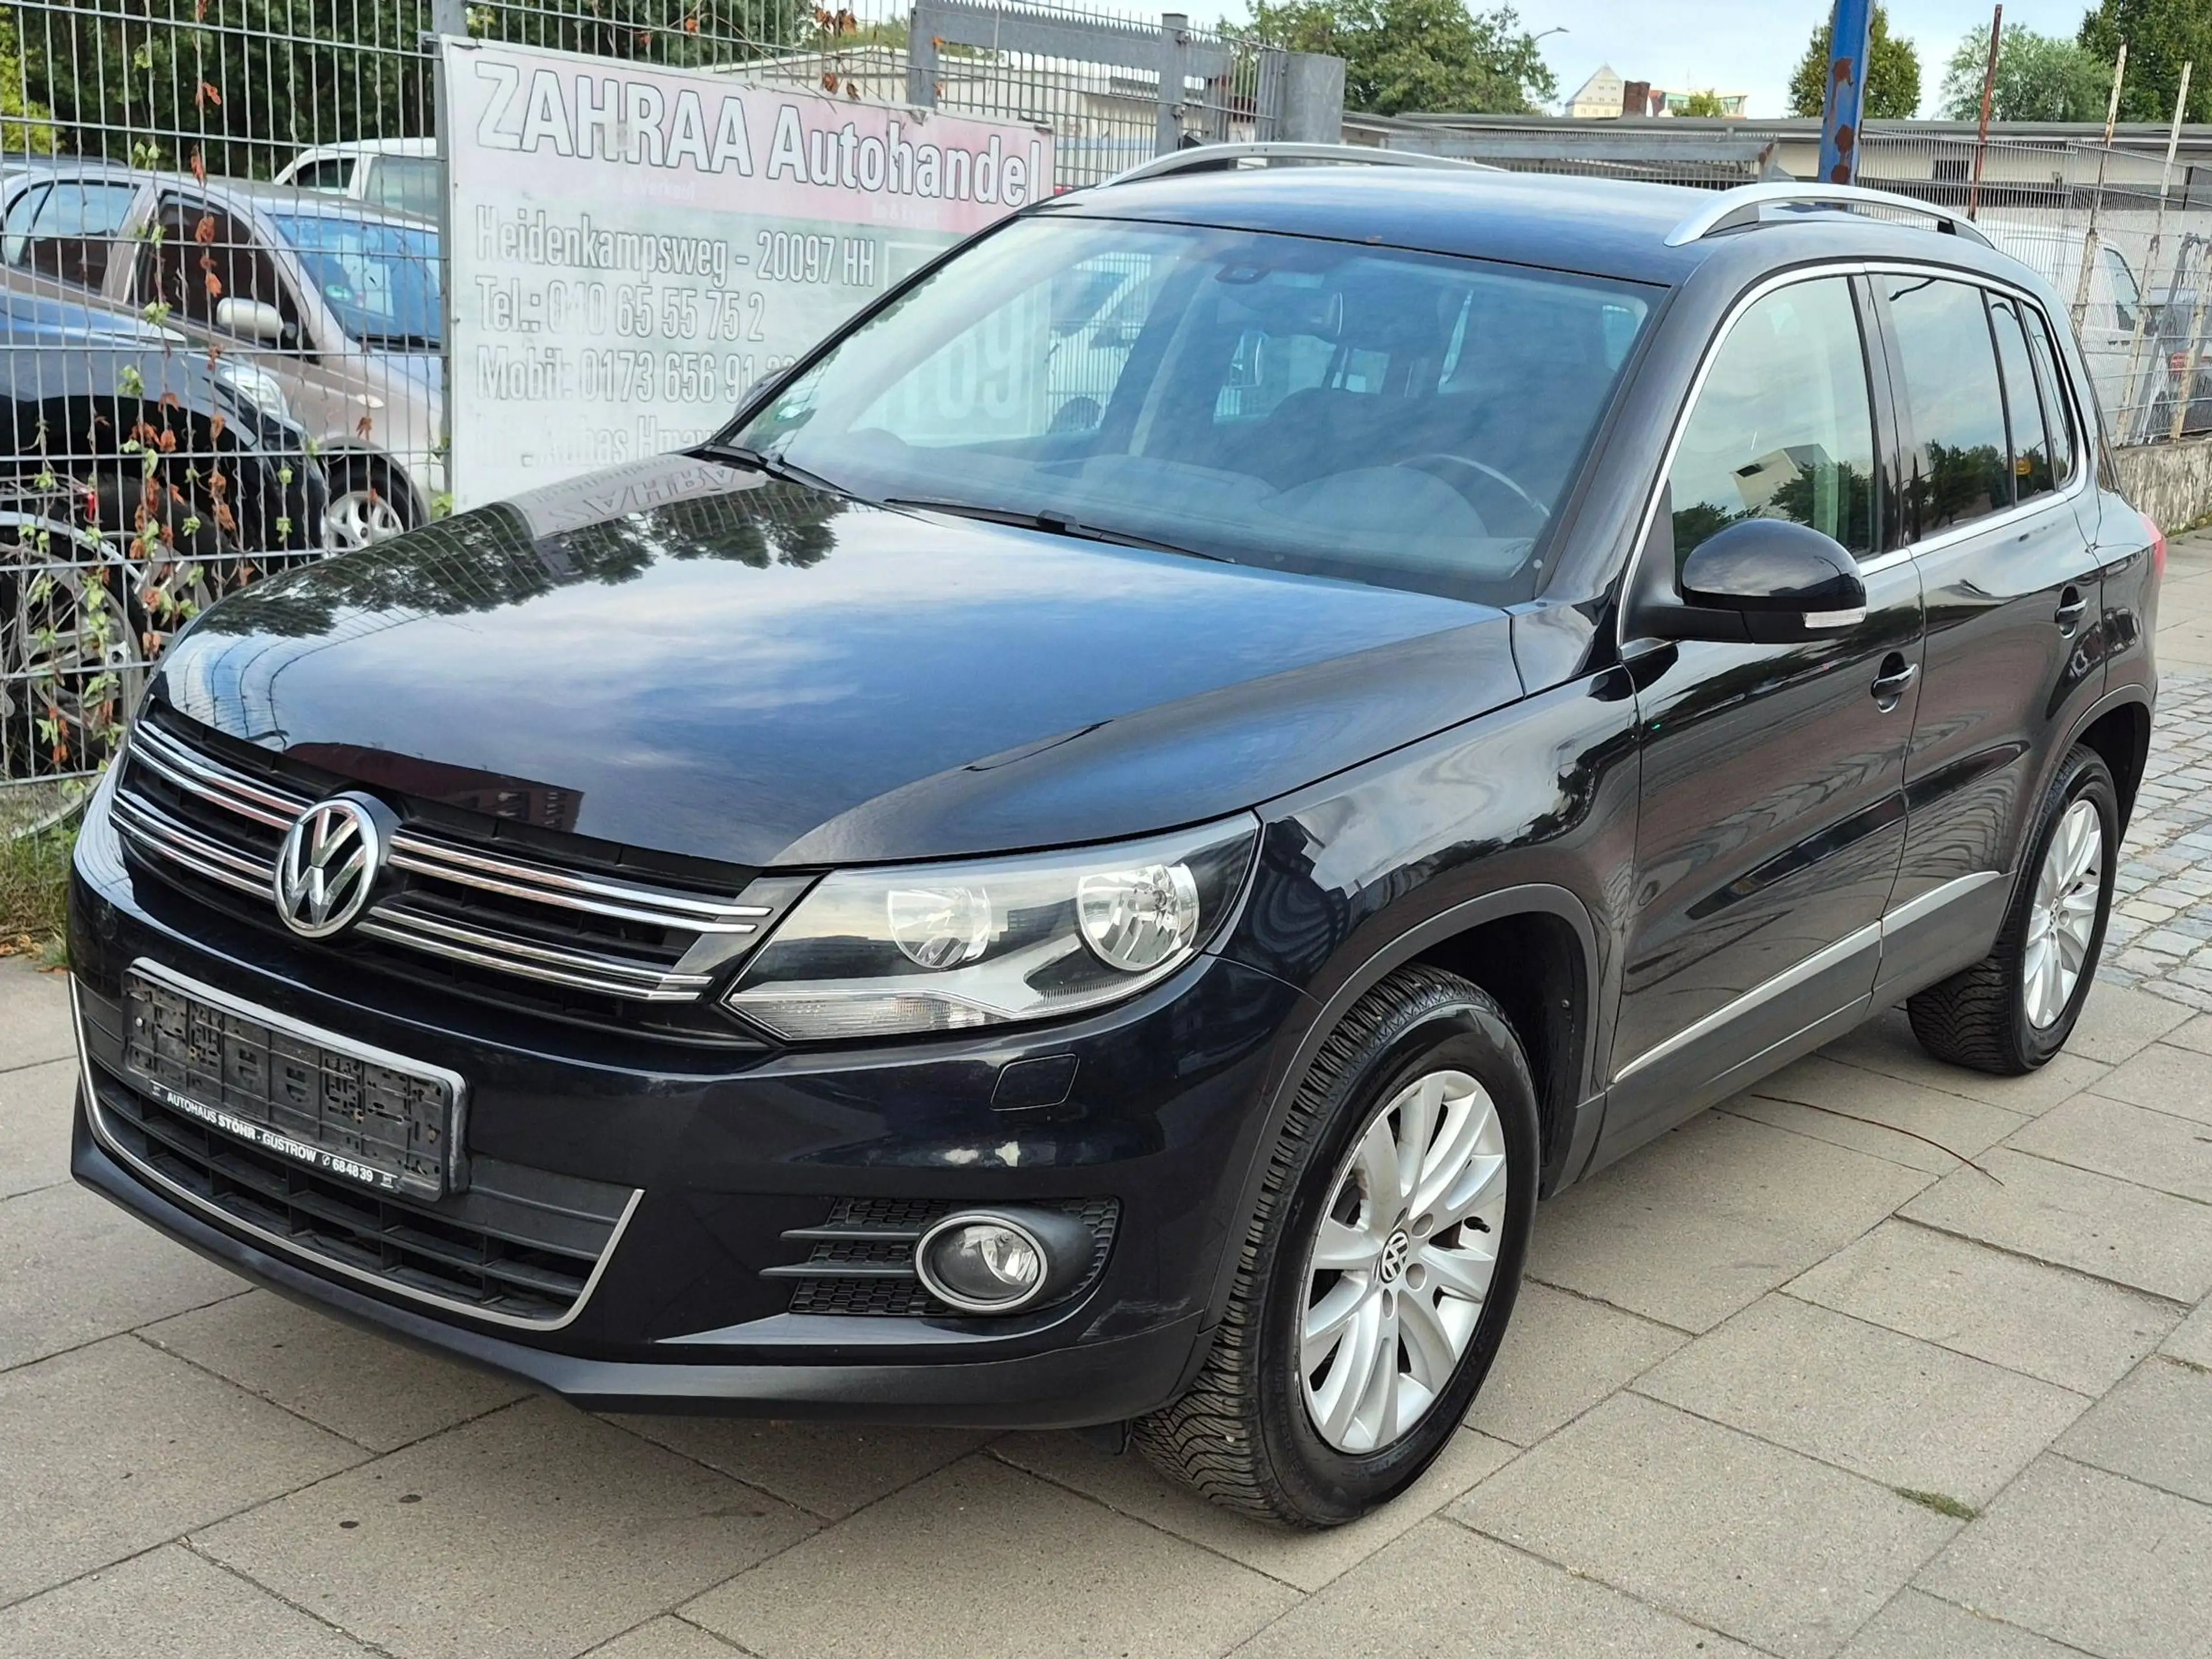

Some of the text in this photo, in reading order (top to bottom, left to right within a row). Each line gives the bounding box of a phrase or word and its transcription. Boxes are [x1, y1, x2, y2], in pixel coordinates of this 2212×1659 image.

[475, 61, 1041, 206] ZAHRAA Autohandel
[476, 205, 875, 287] Heidenkampsweg - 20097 HH
[475, 275, 540, 332] Tel.:
[616, 285, 653, 338] 65
[662, 288, 697, 339] 55
[706, 290, 740, 341] 75
[748, 292, 764, 342] 2
[476, 345, 754, 403] Mobil: 0173 656 91
[166, 1092, 217, 1123] AUTOHAUS
[359, 1167, 373, 1182] 39
